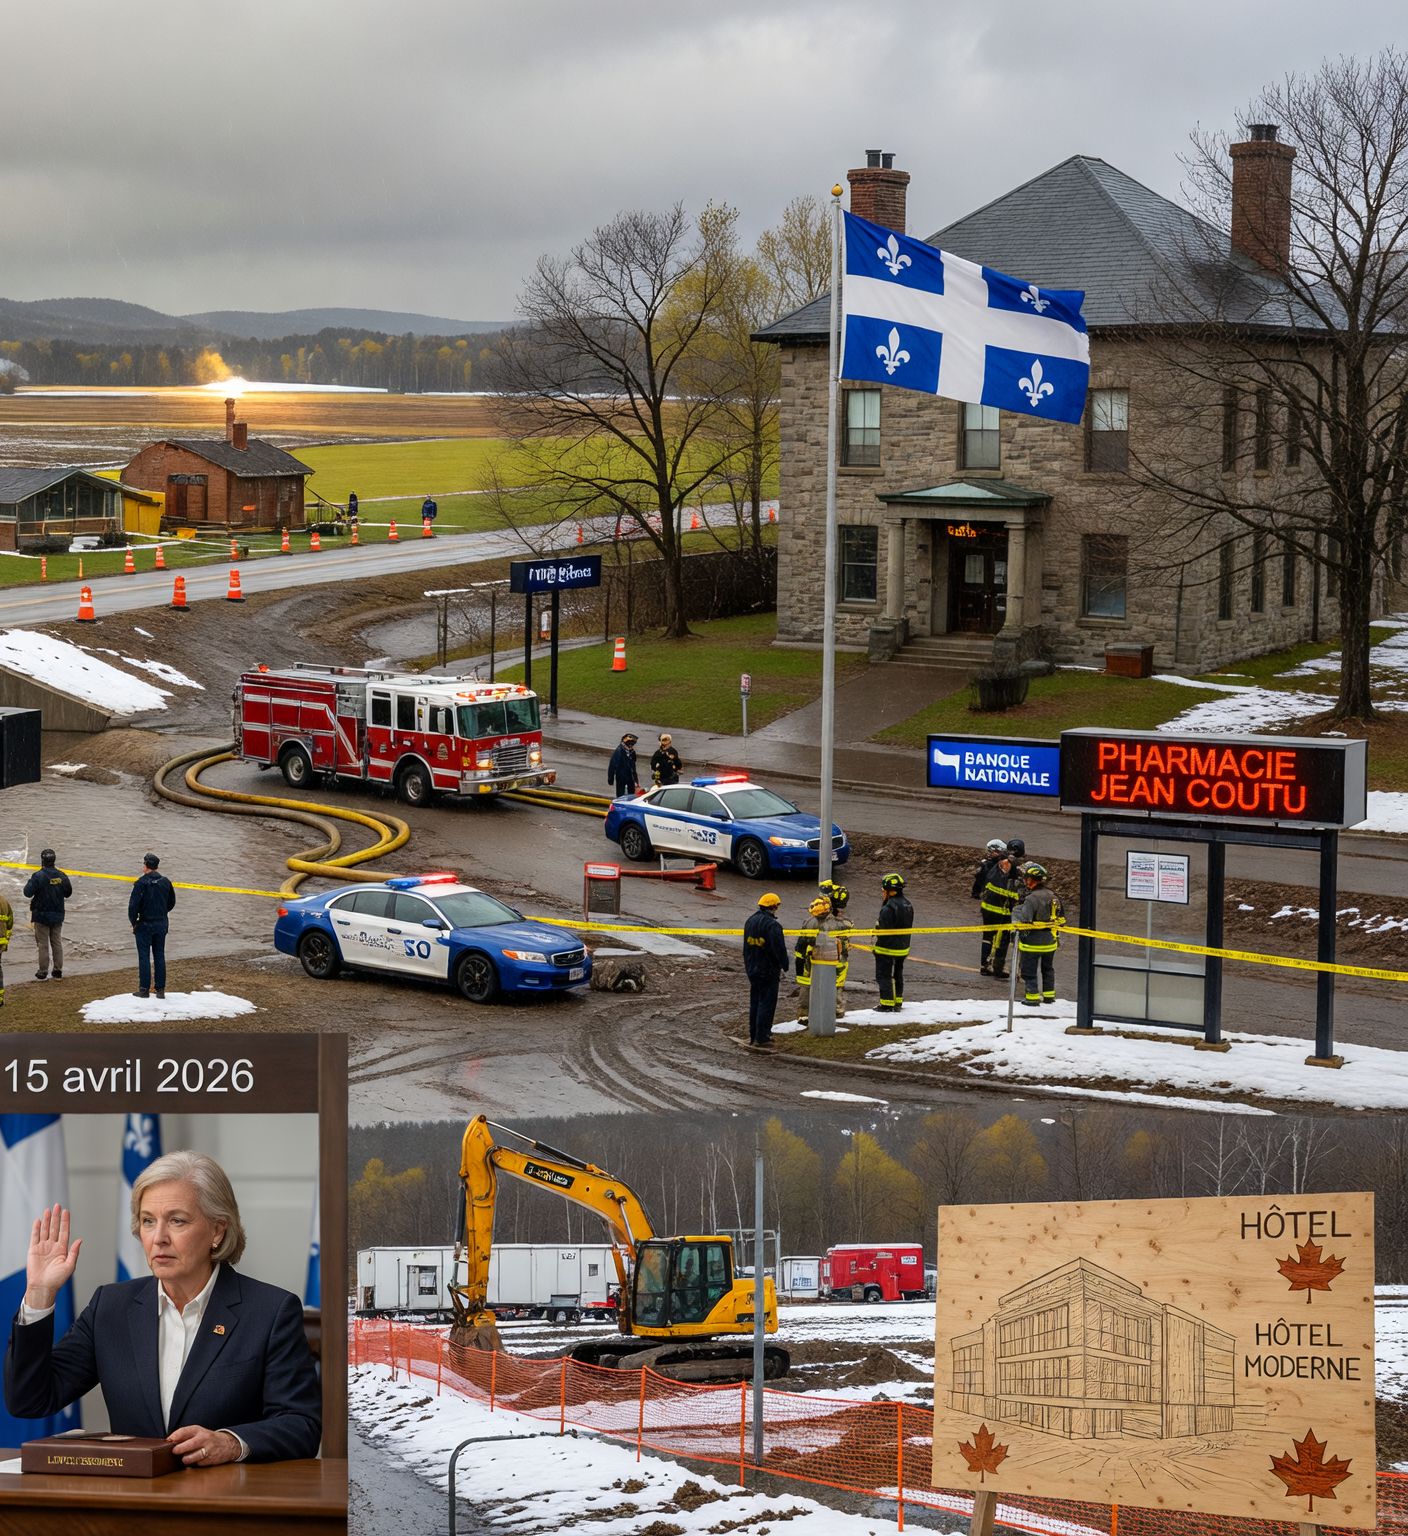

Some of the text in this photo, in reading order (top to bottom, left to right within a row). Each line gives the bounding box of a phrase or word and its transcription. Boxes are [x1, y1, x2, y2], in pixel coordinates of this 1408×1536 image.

[965, 767, 1050, 787] NATIONALE
[1098, 742, 1296, 780] PHARMACIE
[1091, 774, 1306, 813] JEAN COUTU
[1241, 1204, 1352, 1239] HÔTEL
[1255, 1317, 1343, 1346] HÔTEL
[1245, 1354, 1362, 1381] MODERNE
